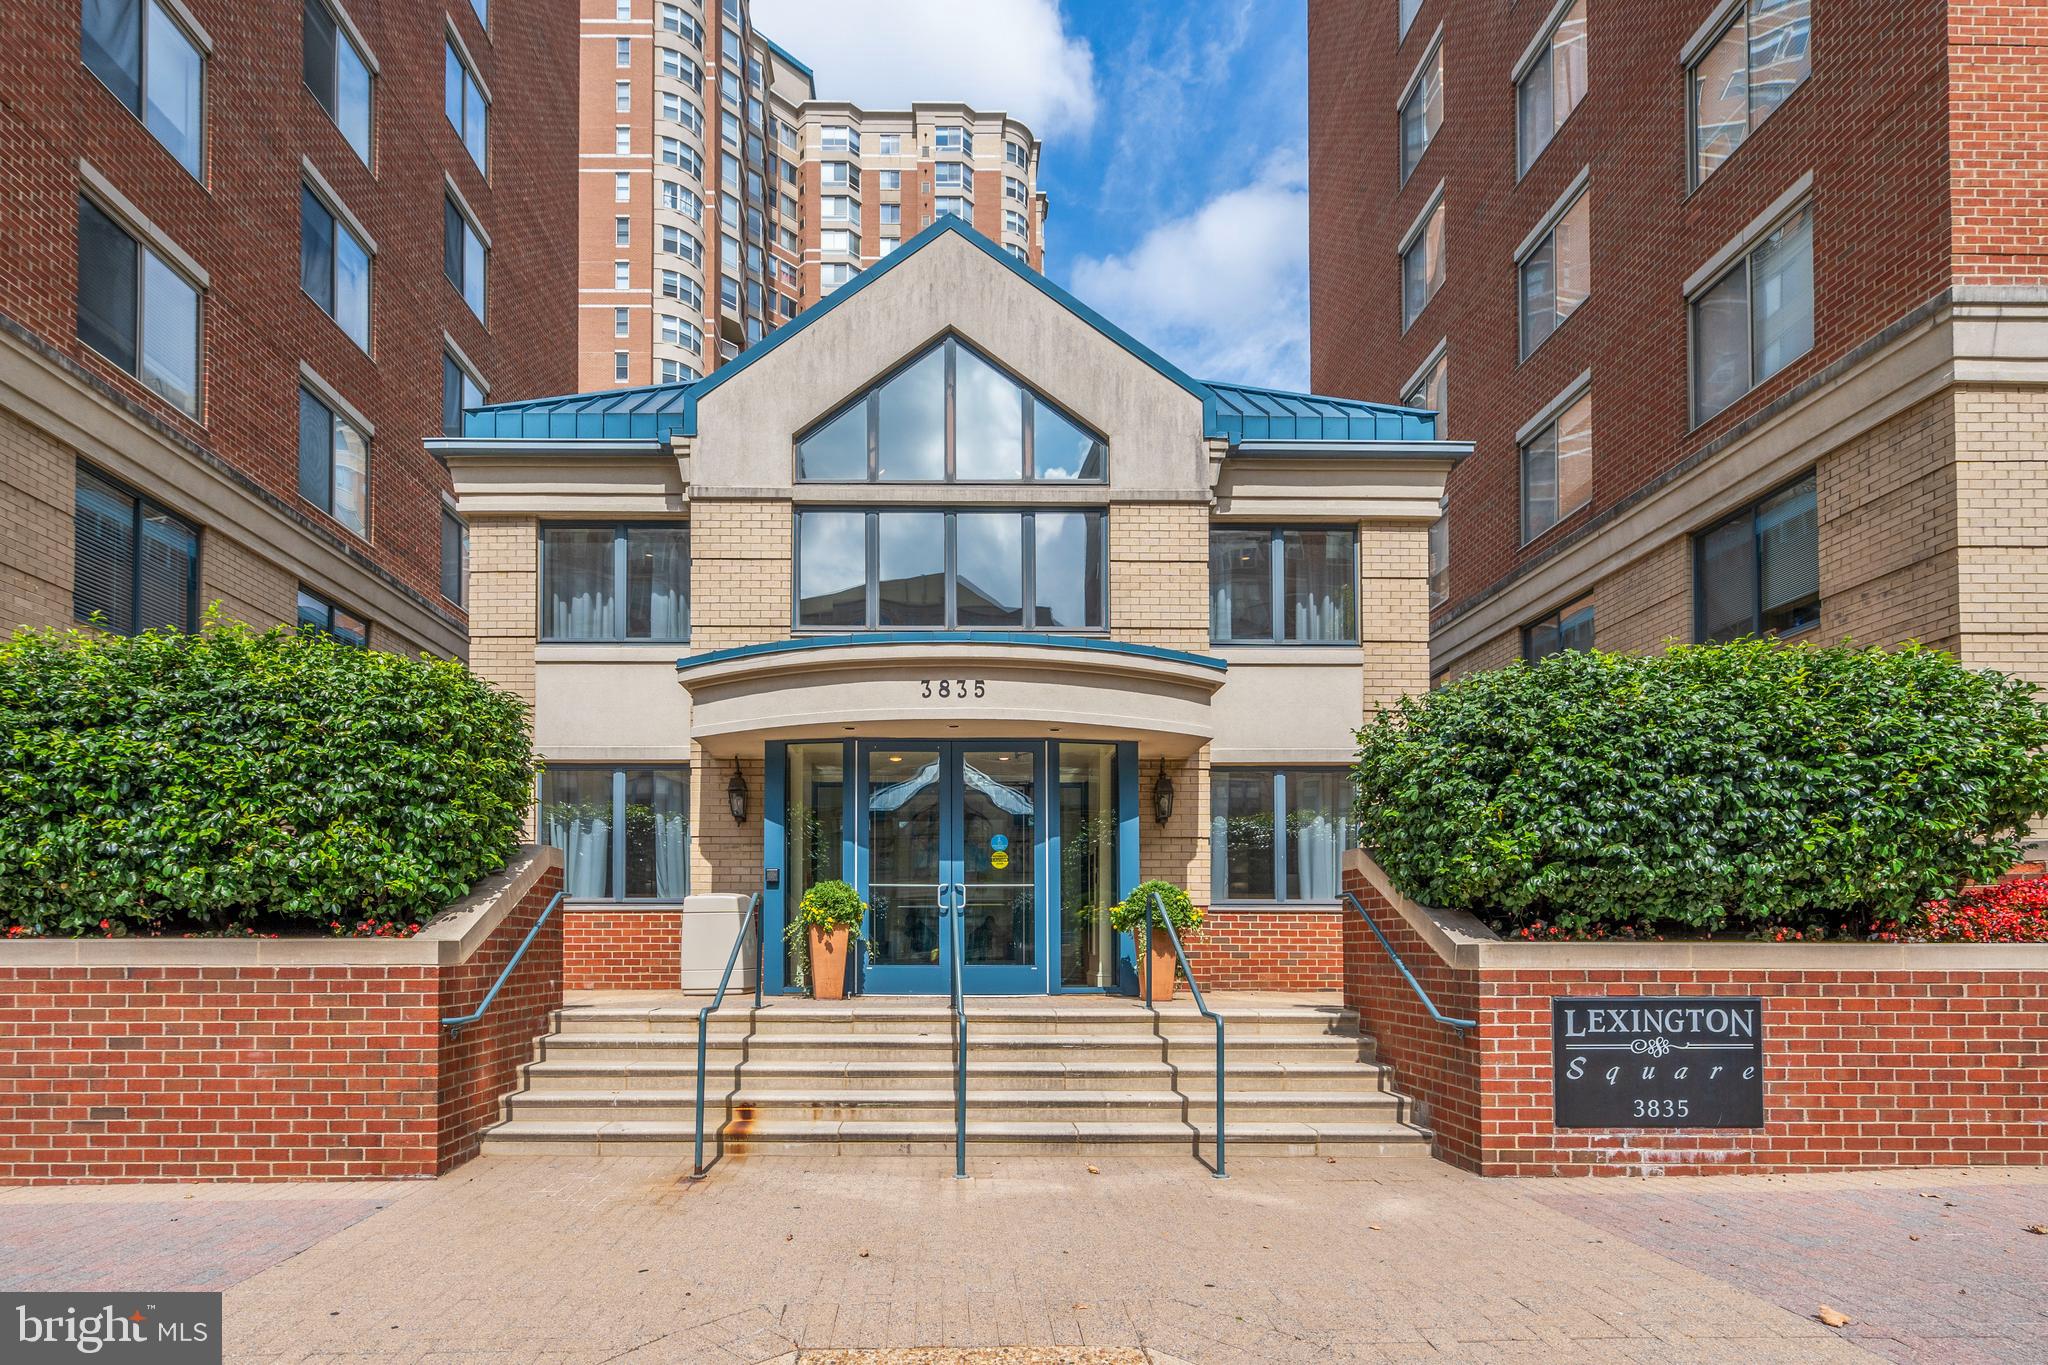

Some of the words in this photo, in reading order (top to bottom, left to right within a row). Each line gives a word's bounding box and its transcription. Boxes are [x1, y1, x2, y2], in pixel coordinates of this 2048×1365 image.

[921, 679, 985, 698] 3835
[1564, 1009, 1754, 1037] LEXINGTON
[1566, 1056, 1755, 1086] Square
[1633, 1099, 1690, 1118] 3835
